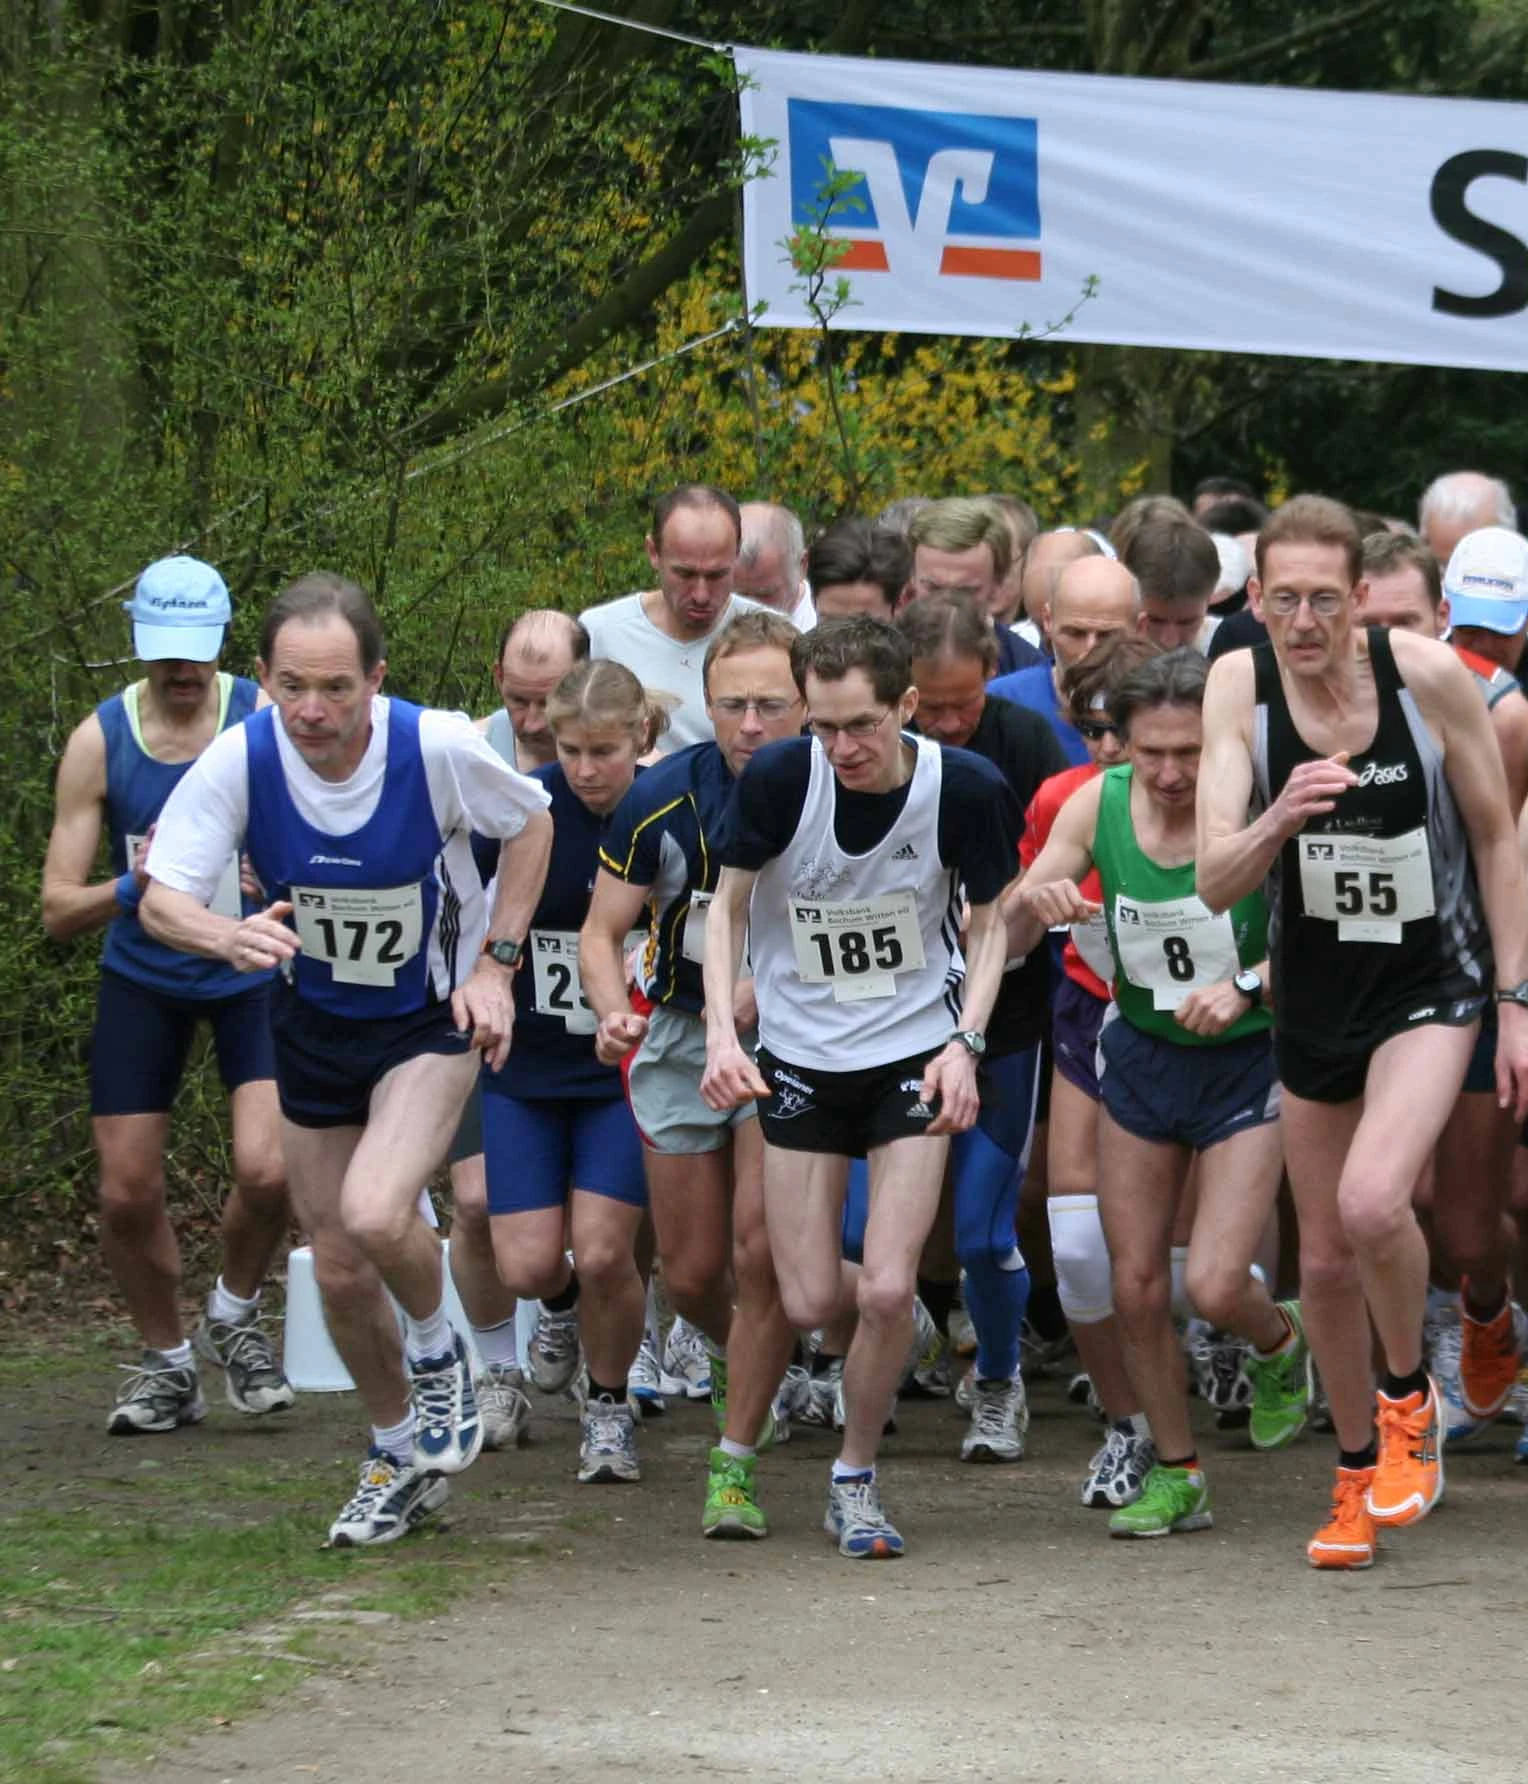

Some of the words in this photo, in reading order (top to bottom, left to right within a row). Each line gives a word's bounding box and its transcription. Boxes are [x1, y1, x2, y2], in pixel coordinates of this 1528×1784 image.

[1371, 762, 1408, 785] asics
[1334, 872, 1398, 917] 55
[314, 918, 405, 964] 172
[810, 925, 903, 977] 185
[1163, 936, 1195, 982] 8
